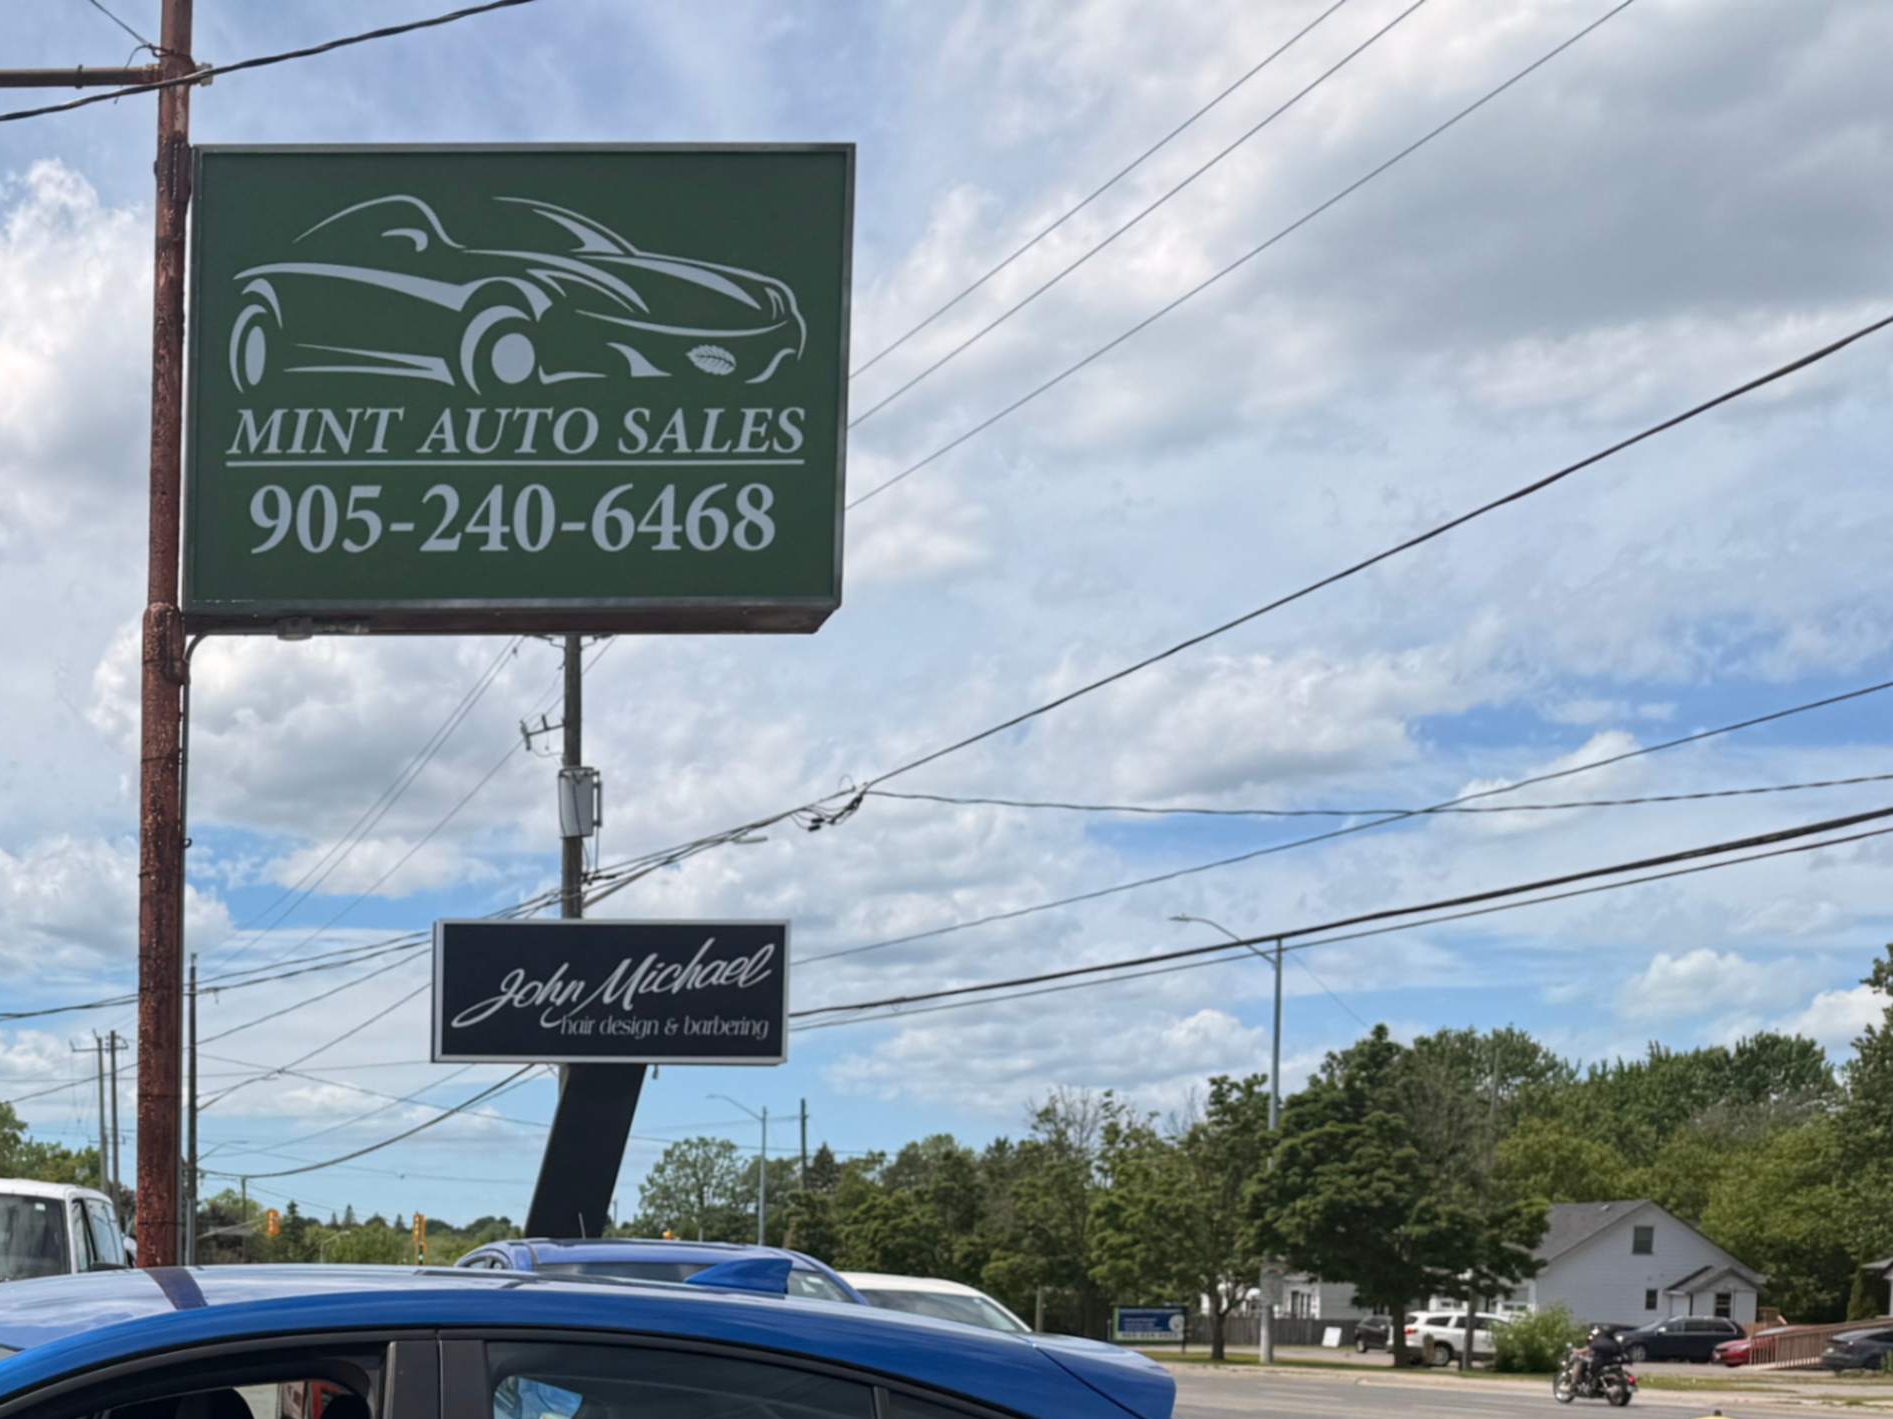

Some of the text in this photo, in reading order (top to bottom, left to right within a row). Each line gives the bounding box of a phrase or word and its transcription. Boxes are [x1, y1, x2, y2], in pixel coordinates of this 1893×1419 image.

[226, 406, 805, 455] MINT AUTO SALES
[249, 482, 776, 555] 905-240-6468
[451, 937, 775, 1029] John Michael
[560, 1014, 770, 1040] hair design & barbering
